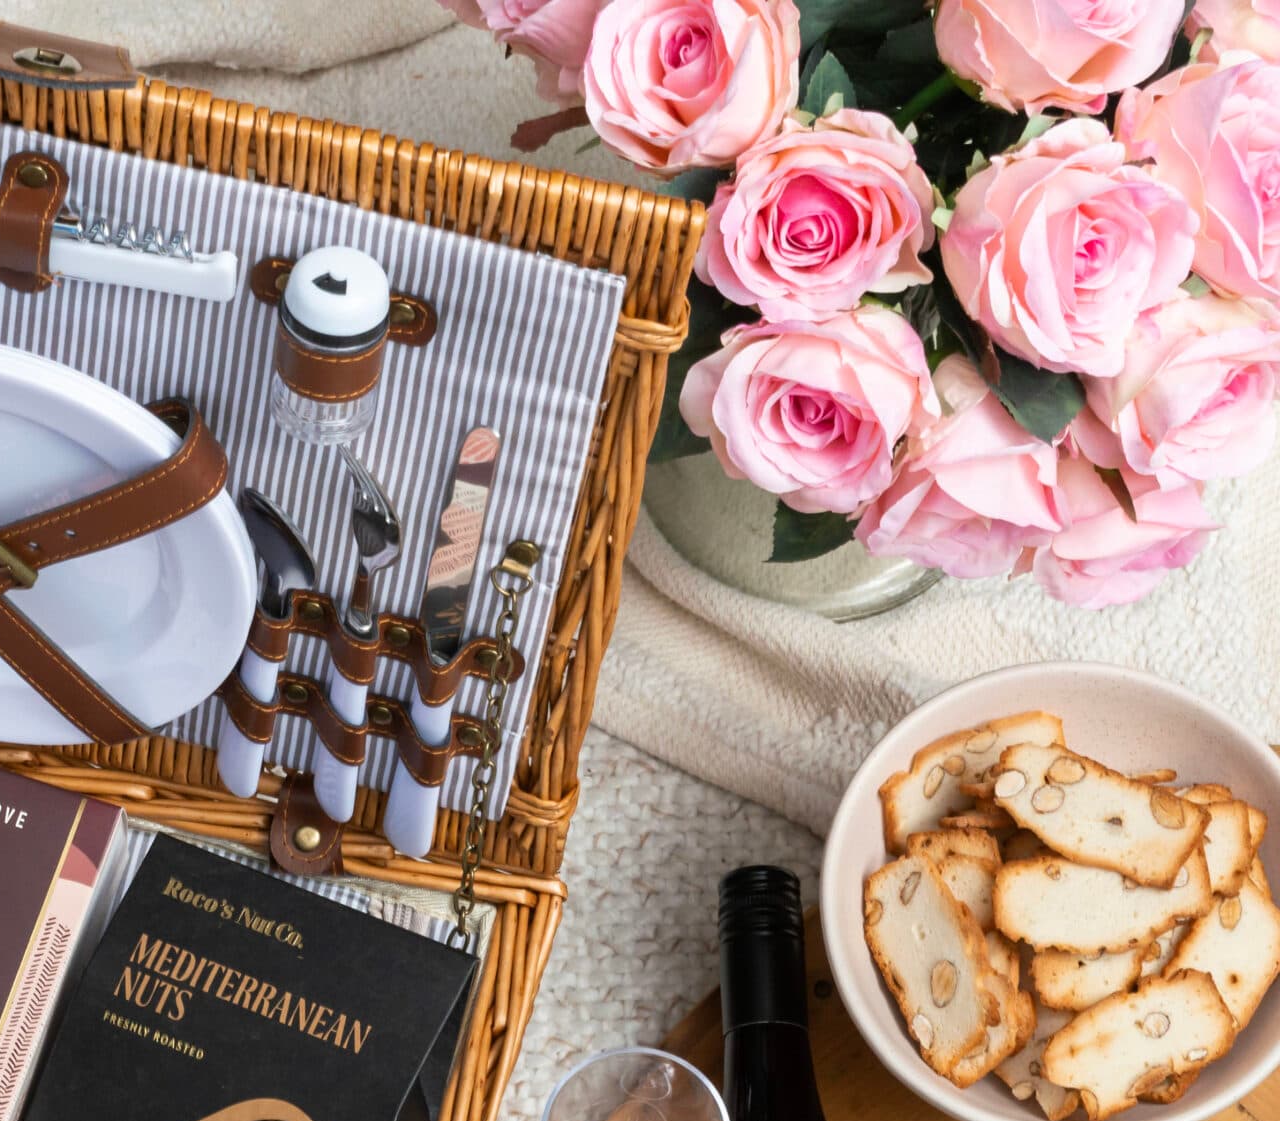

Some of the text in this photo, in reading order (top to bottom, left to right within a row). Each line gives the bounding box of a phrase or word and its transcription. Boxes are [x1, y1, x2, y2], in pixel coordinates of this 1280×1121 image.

[162, 875, 304, 949] Roco's Nut Co.
[113, 966, 193, 1021] NUTS
[129, 933, 372, 1055] MEDITERRANEAN
[103, 1009, 204, 1060] FRESHLY ROASTED
